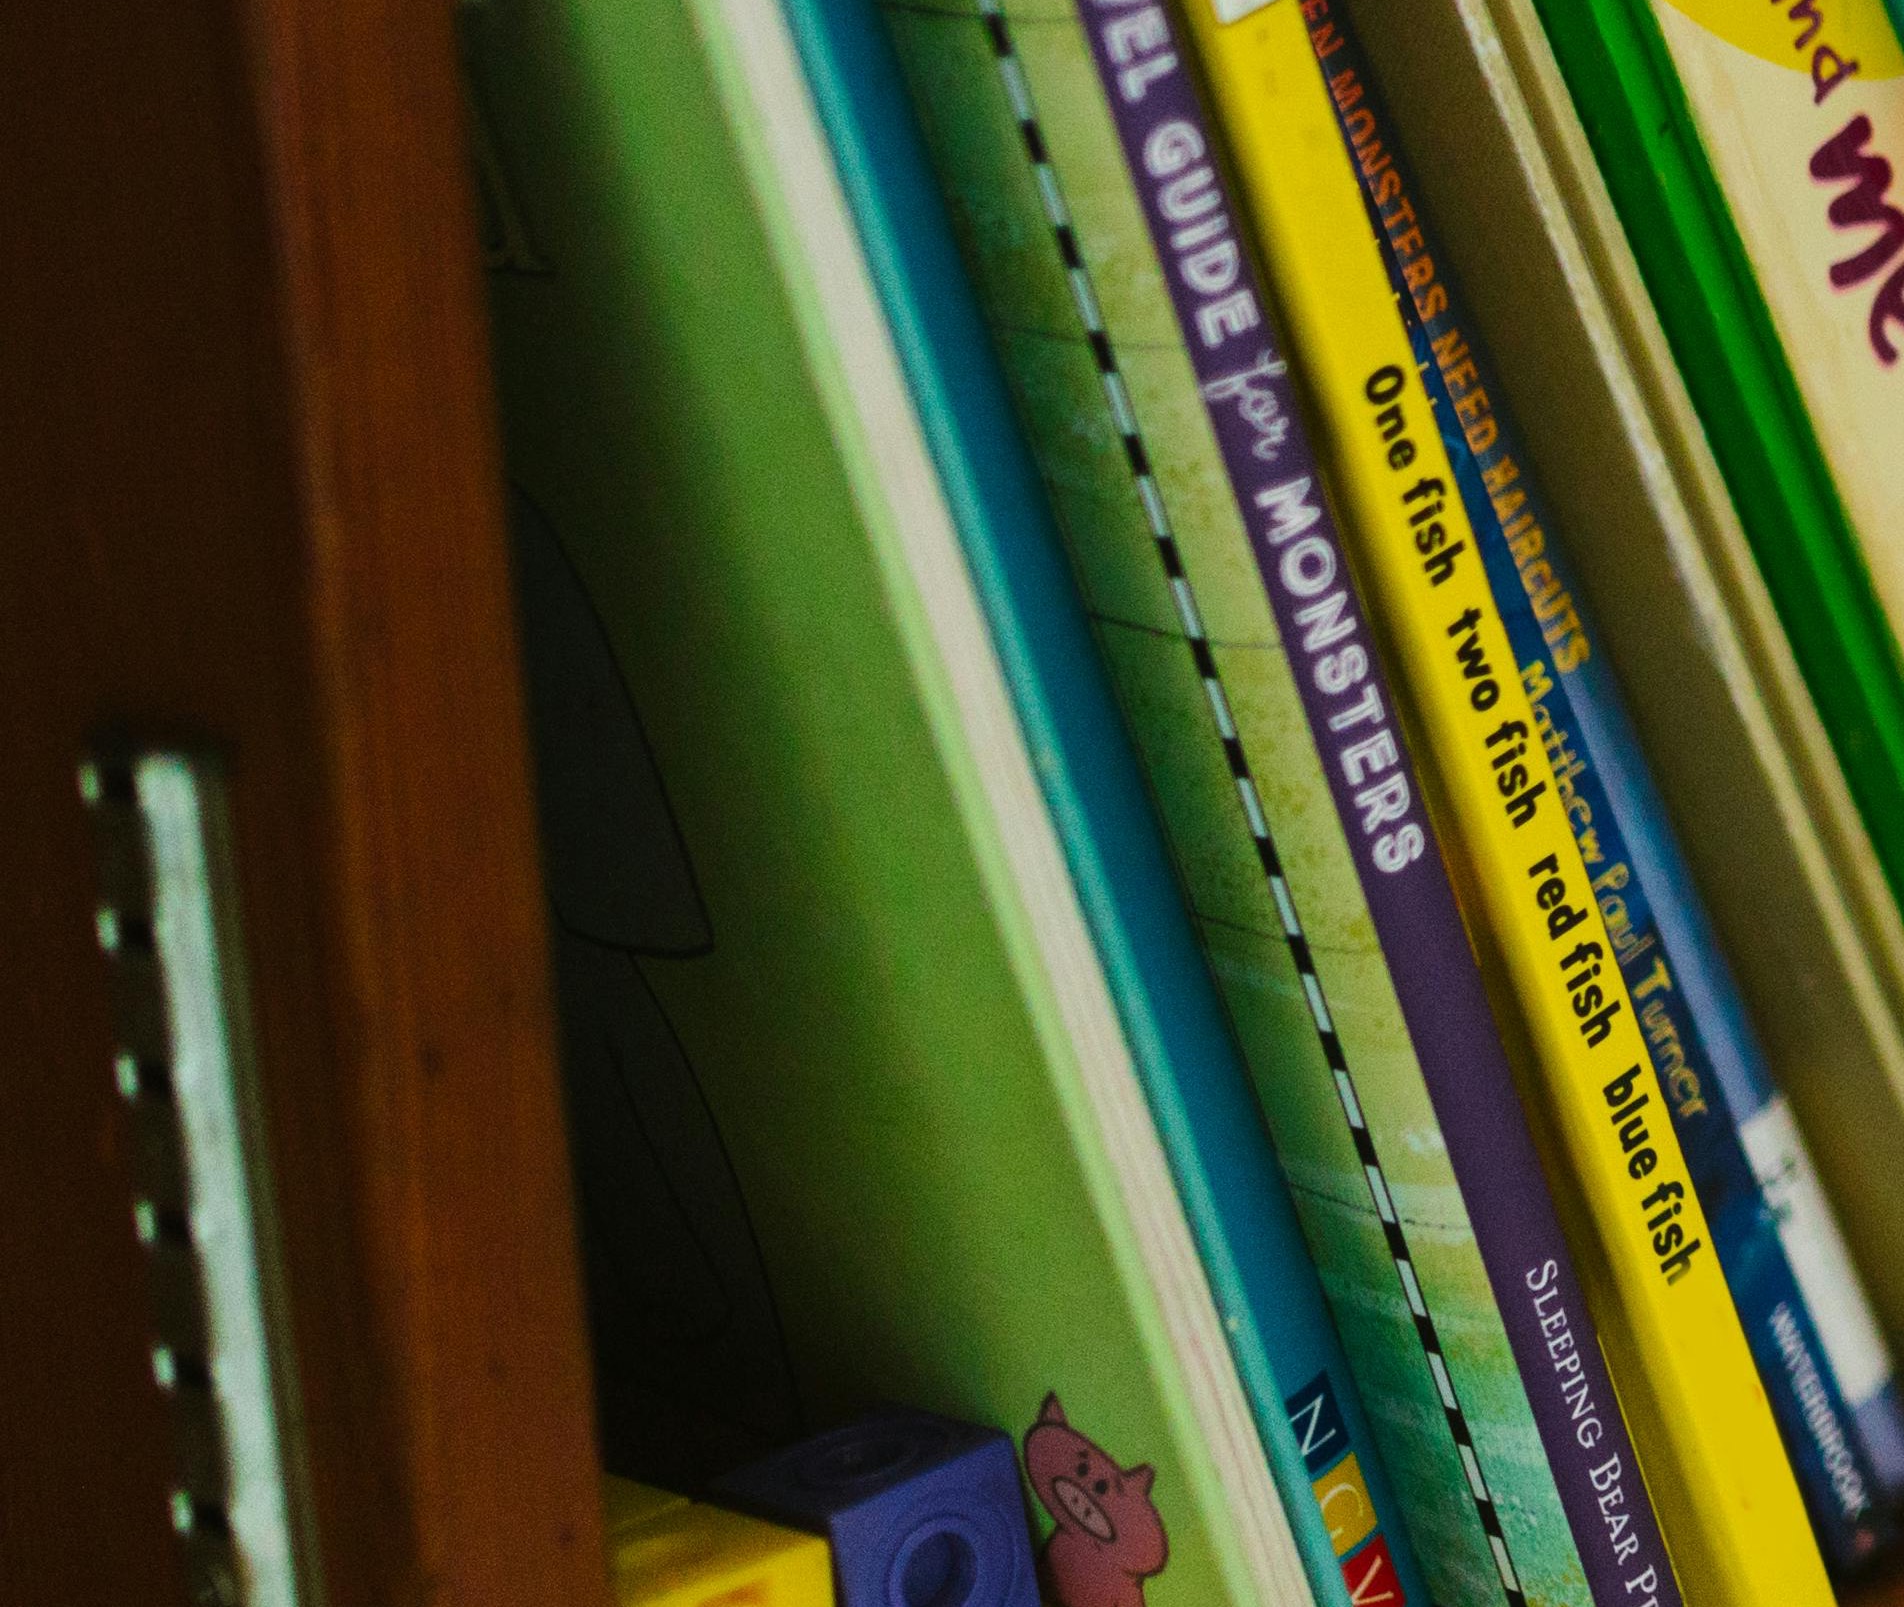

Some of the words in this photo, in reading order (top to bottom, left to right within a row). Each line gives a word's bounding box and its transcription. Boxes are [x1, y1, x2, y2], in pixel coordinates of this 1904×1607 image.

[1144, 123, 1259, 348] GUIDE
[1205, 349, 1289, 463] for
[1254, 475, 1425, 875] MONSTERS
[1330, 67, 1449, 324] MONSTERS
[1431, 327, 1499, 456] NEED
[1482, 453, 1591, 675] HAIRCUTS
[1365, 364, 1415, 470] One
[1402, 477, 1466, 588] fish
[1447, 607, 1500, 714] two
[1485, 718, 1548, 830] fish
[1527, 852, 1588, 942] red
[1560, 941, 1622, 1050] fish
[1603, 1064, 1658, 1180] blue
[1641, 1179, 1702, 1287] fish
[1520, 659, 1604, 865] Matthew
[1593, 861, 1657, 966] Paul
[1634, 955, 1709, 1118] Turner
[1525, 1258, 1603, 1450] SLEEPING
[1588, 1452, 1639, 1566] BEAR
